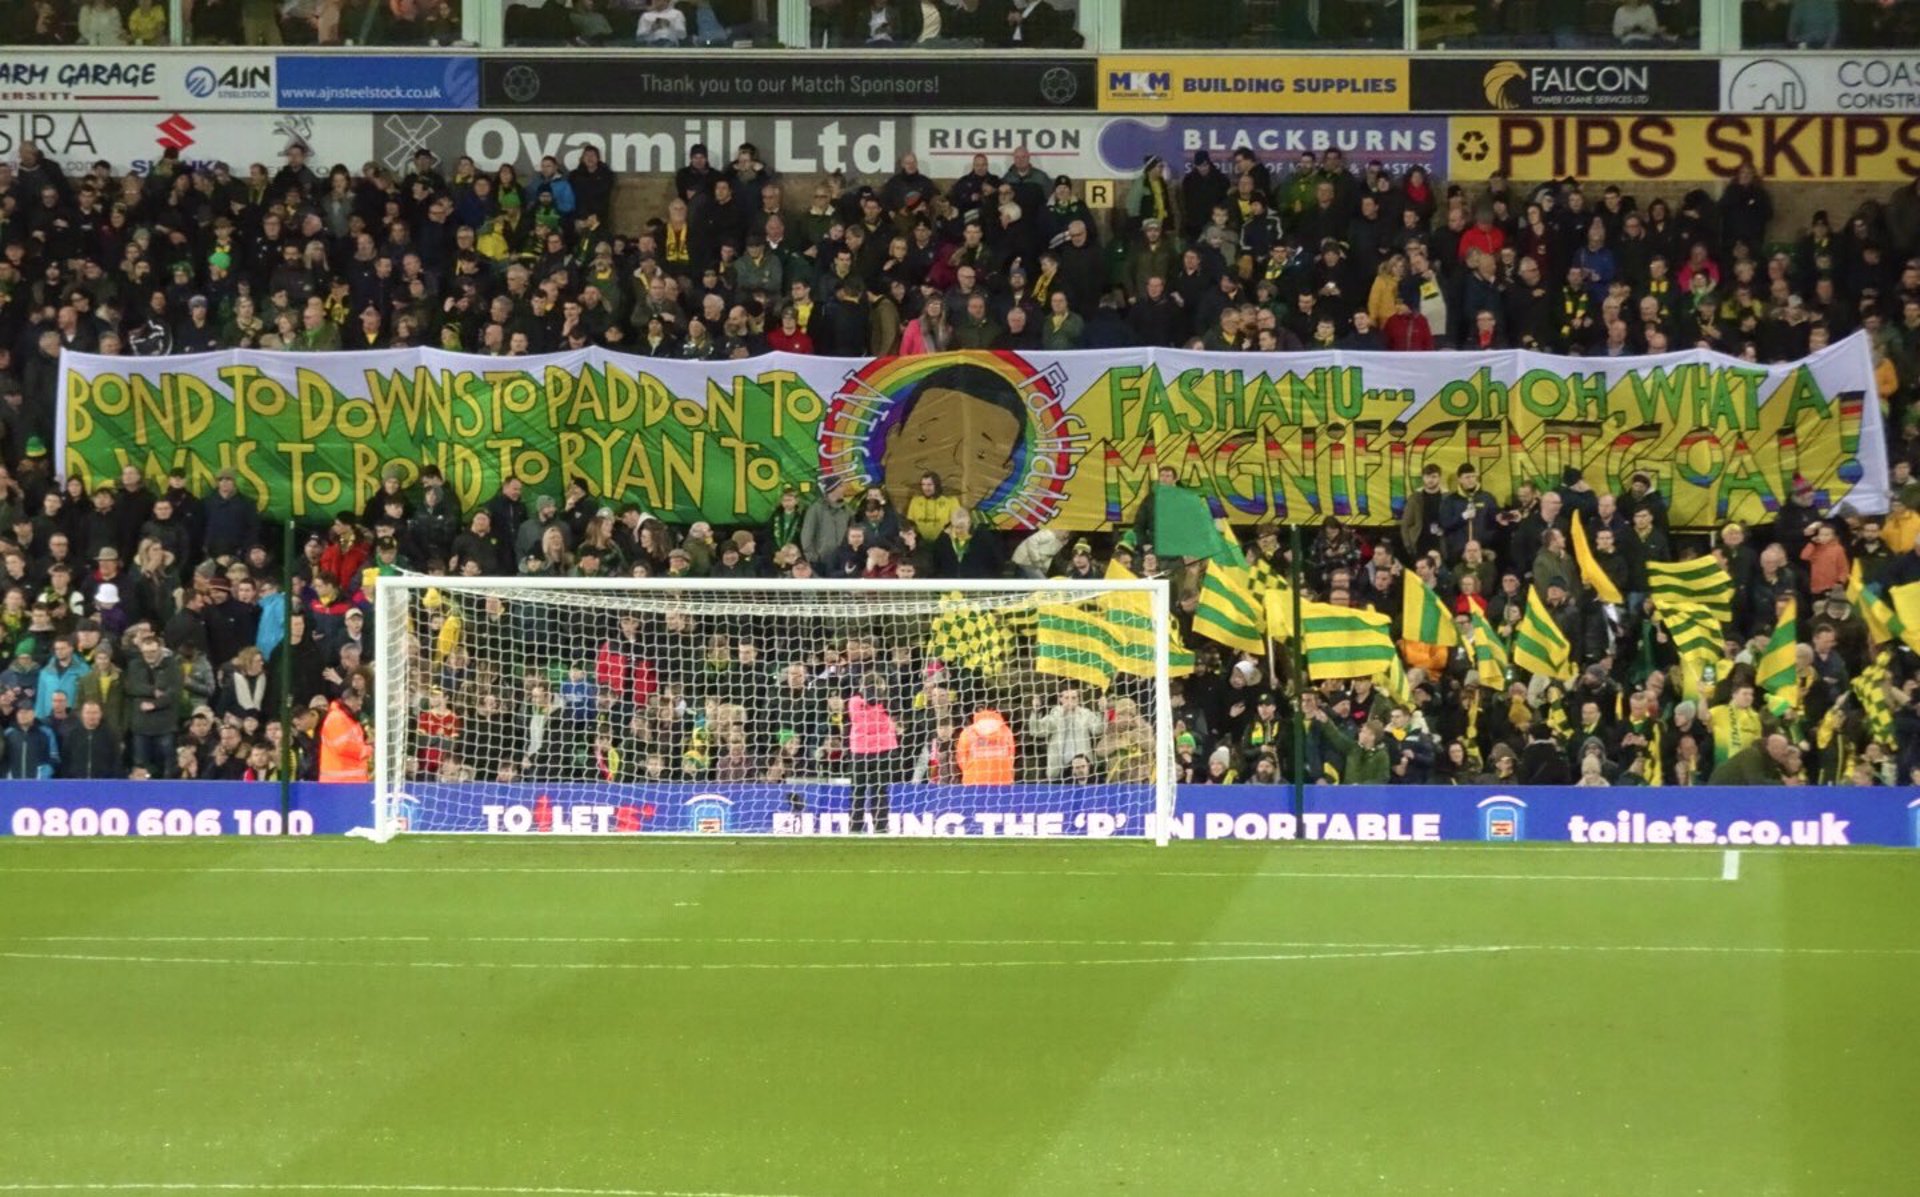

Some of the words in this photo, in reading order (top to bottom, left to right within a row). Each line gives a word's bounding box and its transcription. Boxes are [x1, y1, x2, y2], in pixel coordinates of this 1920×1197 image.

[58, 63, 156, 87] GARAGE
[218, 66, 270, 88] AJN
[641, 74, 694, 92] Thank
[699, 80, 729, 96] you
[735, 77, 752, 92] to
[758, 80, 786, 92] our
[792, 75, 845, 92] Match
[850, 76, 940, 96] Sponsors!
[1110, 72, 1170, 91] MKM
[1183, 77, 1285, 93] BUILDING
[1292, 78, 1397, 94] SUPPLIES
[1531, 66, 1648, 92] FALCON
[281, 86, 441, 101] www.ajnsteelstock.co.uk
[775, 120, 896, 173] Ltd
[929, 129, 1080, 149] RIGHTON
[1184, 129, 1436, 151] BLACKBURNS
[1500, 117, 1677, 178] PIPS
[1091, 185, 1107, 203] R
[66, 368, 215, 446] BOND
[218, 364, 286, 438] TO
[295, 366, 484, 440] DOWNS
[483, 370, 537, 433] TO
[544, 361, 745, 440] PADDON
[758, 370, 823, 438] TO
[1628, 362, 1769, 432] WHAT
[1785, 363, 1833, 429] A
[278, 442, 342, 516] TO
[559, 427, 705, 512] RYAN
[12, 808, 130, 837] 0800
[136, 809, 222, 837] 606
[233, 809, 314, 836] 100
[975, 813, 1064, 836] THE
[1205, 812, 1441, 841] PORTABLE
[1568, 811, 1850, 846] toilets.co.uk
